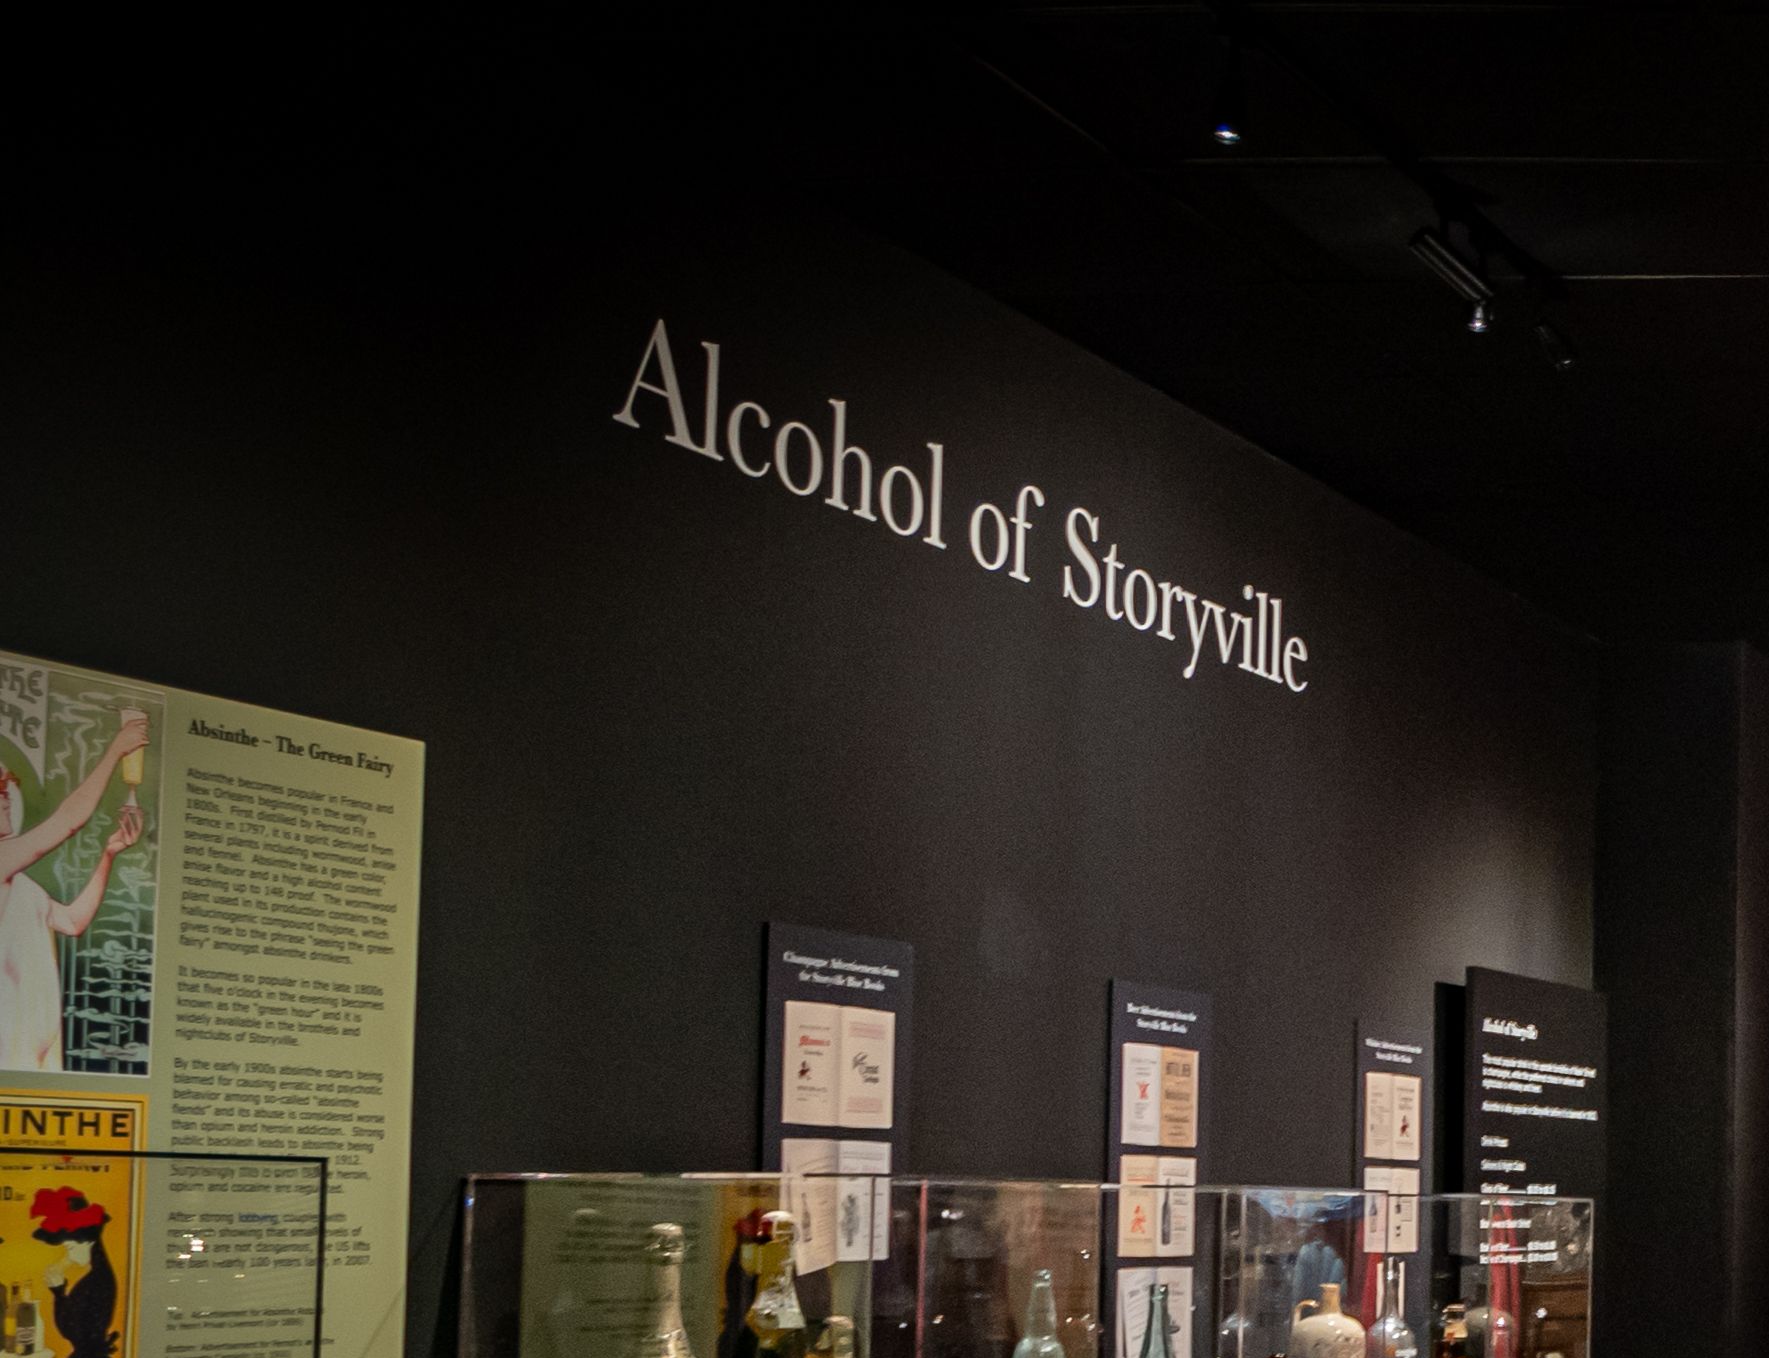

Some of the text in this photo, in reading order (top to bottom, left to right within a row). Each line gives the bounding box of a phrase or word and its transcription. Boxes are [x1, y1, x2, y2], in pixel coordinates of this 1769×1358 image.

[612, 319, 1309, 692] Alcohol of Storyville
[188, 719, 259, 748] Absinthe
[275, 735, 305, 757] The
[308, 743, 354, 767] Green
[356, 752, 395, 778] Fairy
[3, 1109, 130, 1138] INTHE
